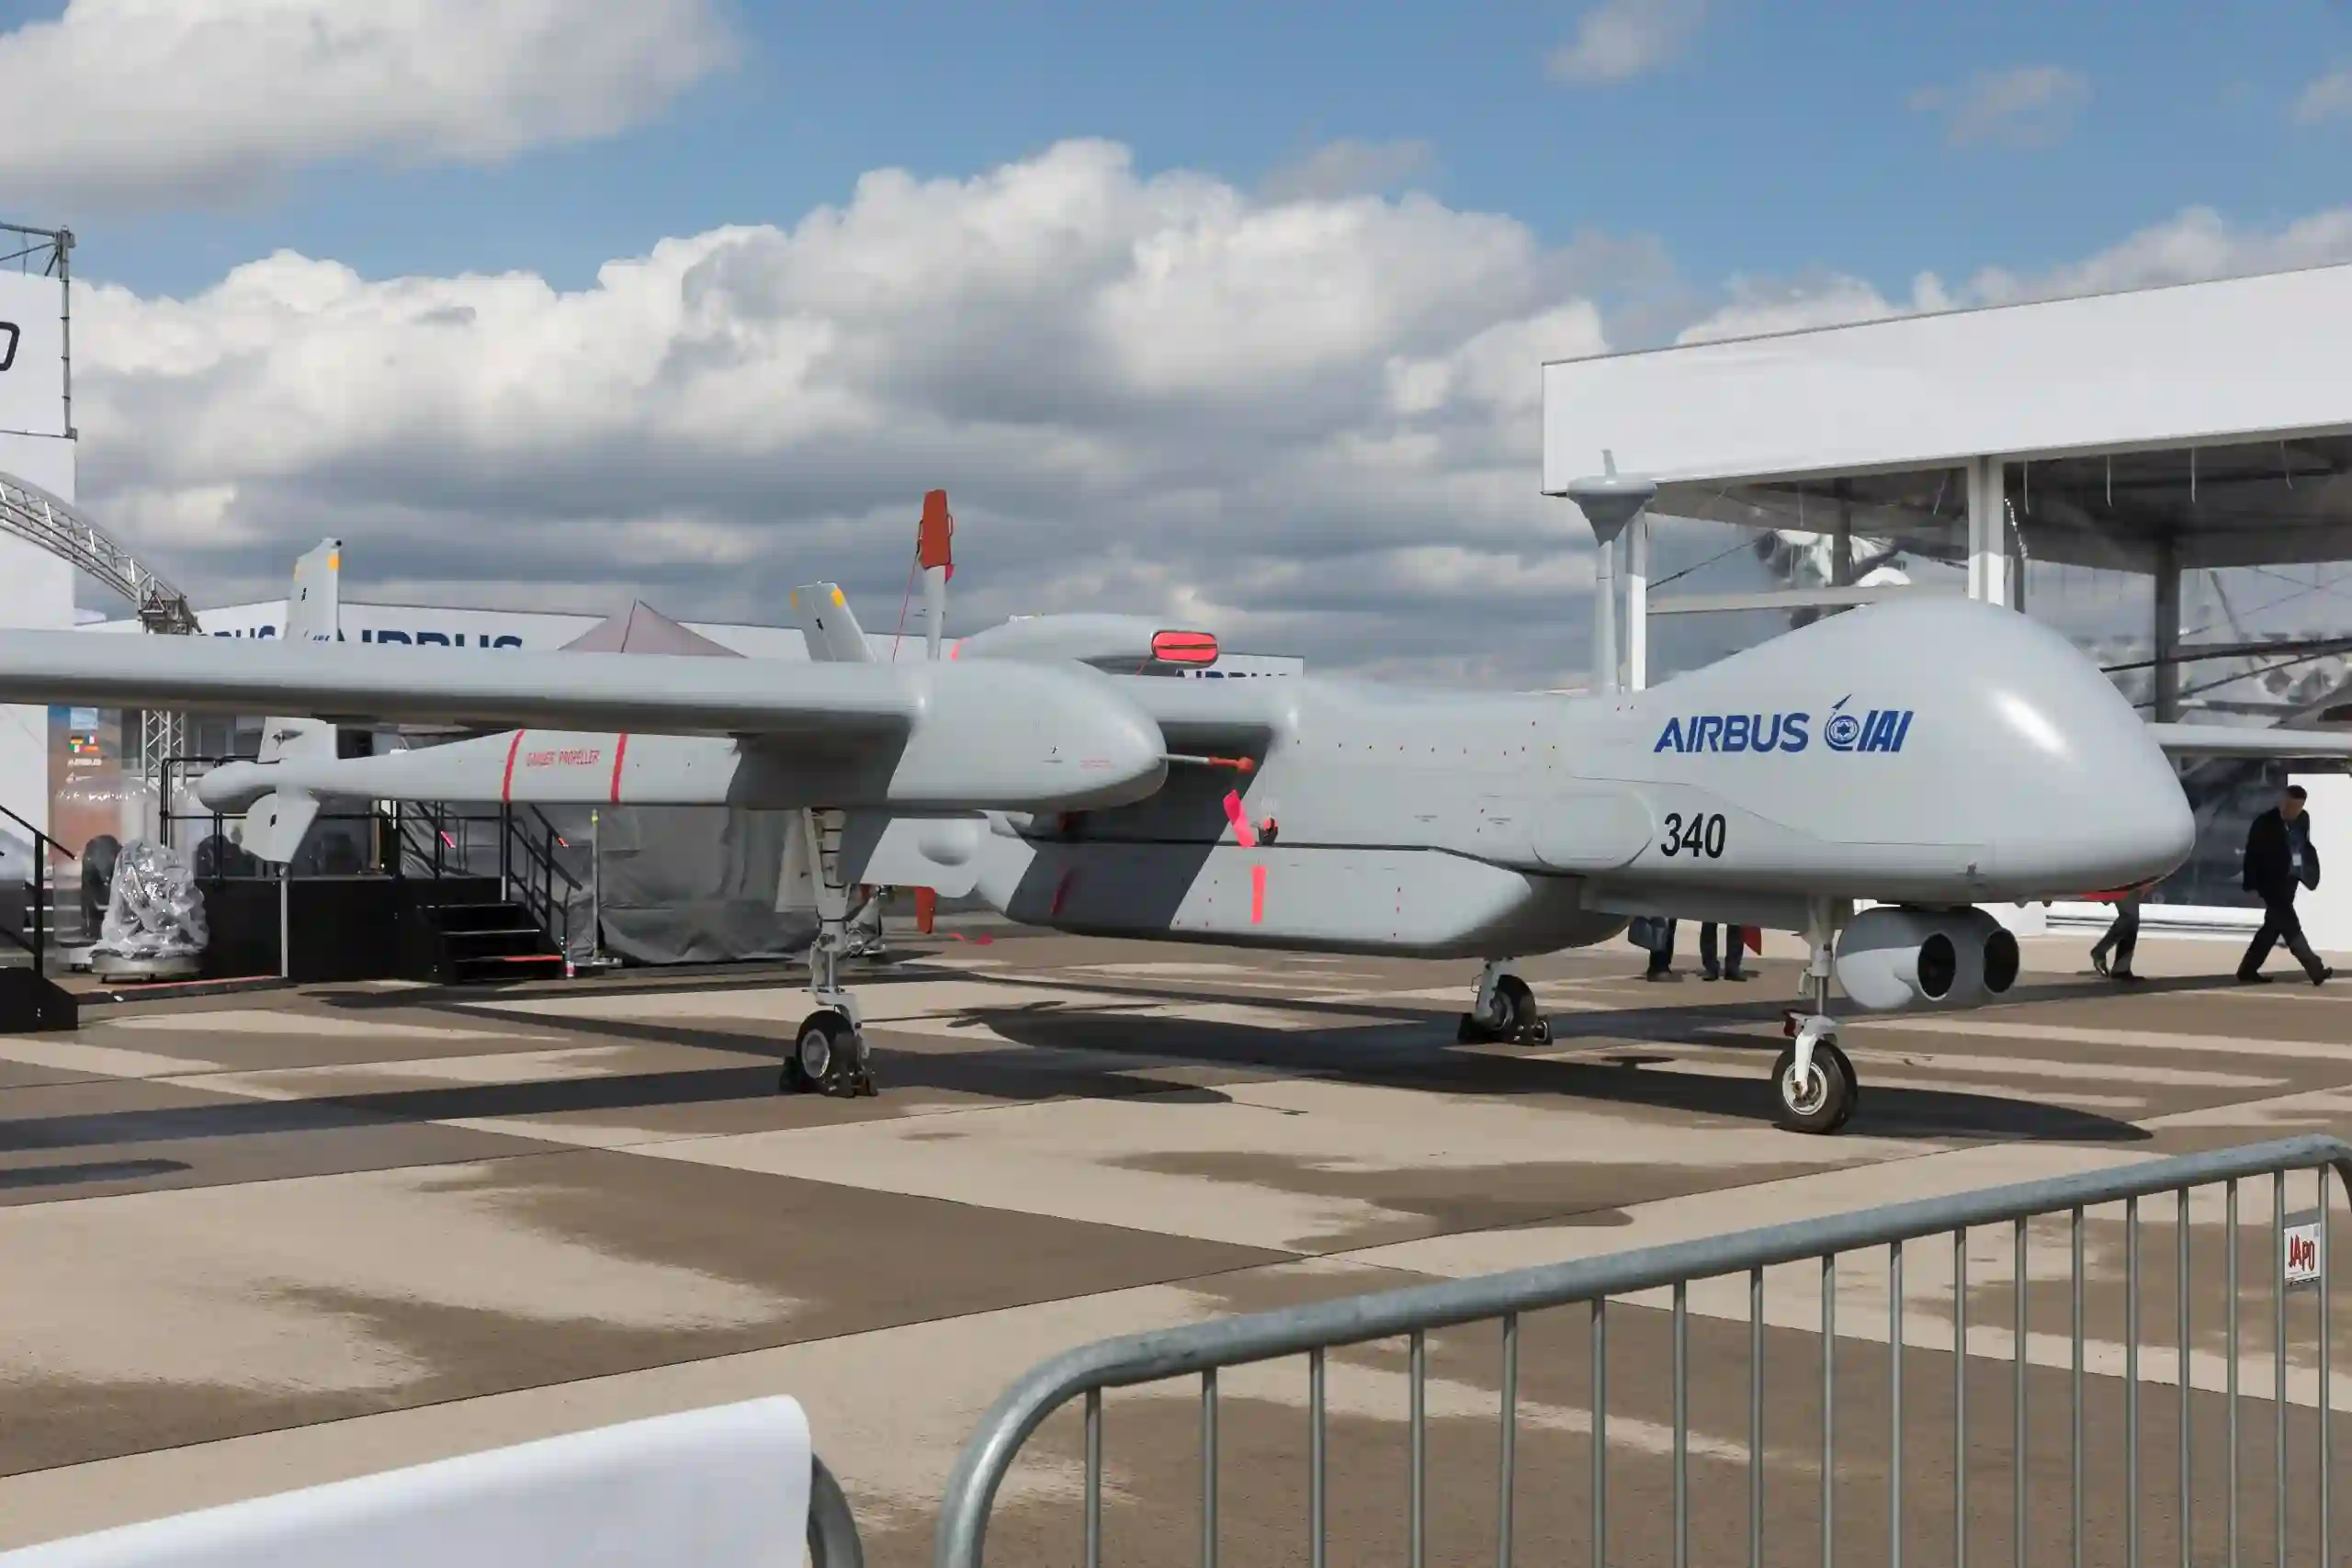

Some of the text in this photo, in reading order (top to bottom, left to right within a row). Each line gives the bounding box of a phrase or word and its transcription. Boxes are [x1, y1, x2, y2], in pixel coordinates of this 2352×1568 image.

[1653, 712, 1810, 753] AIRBUS
[1857, 709, 1914, 753] IAI
[1660, 812, 1726, 859] 340
